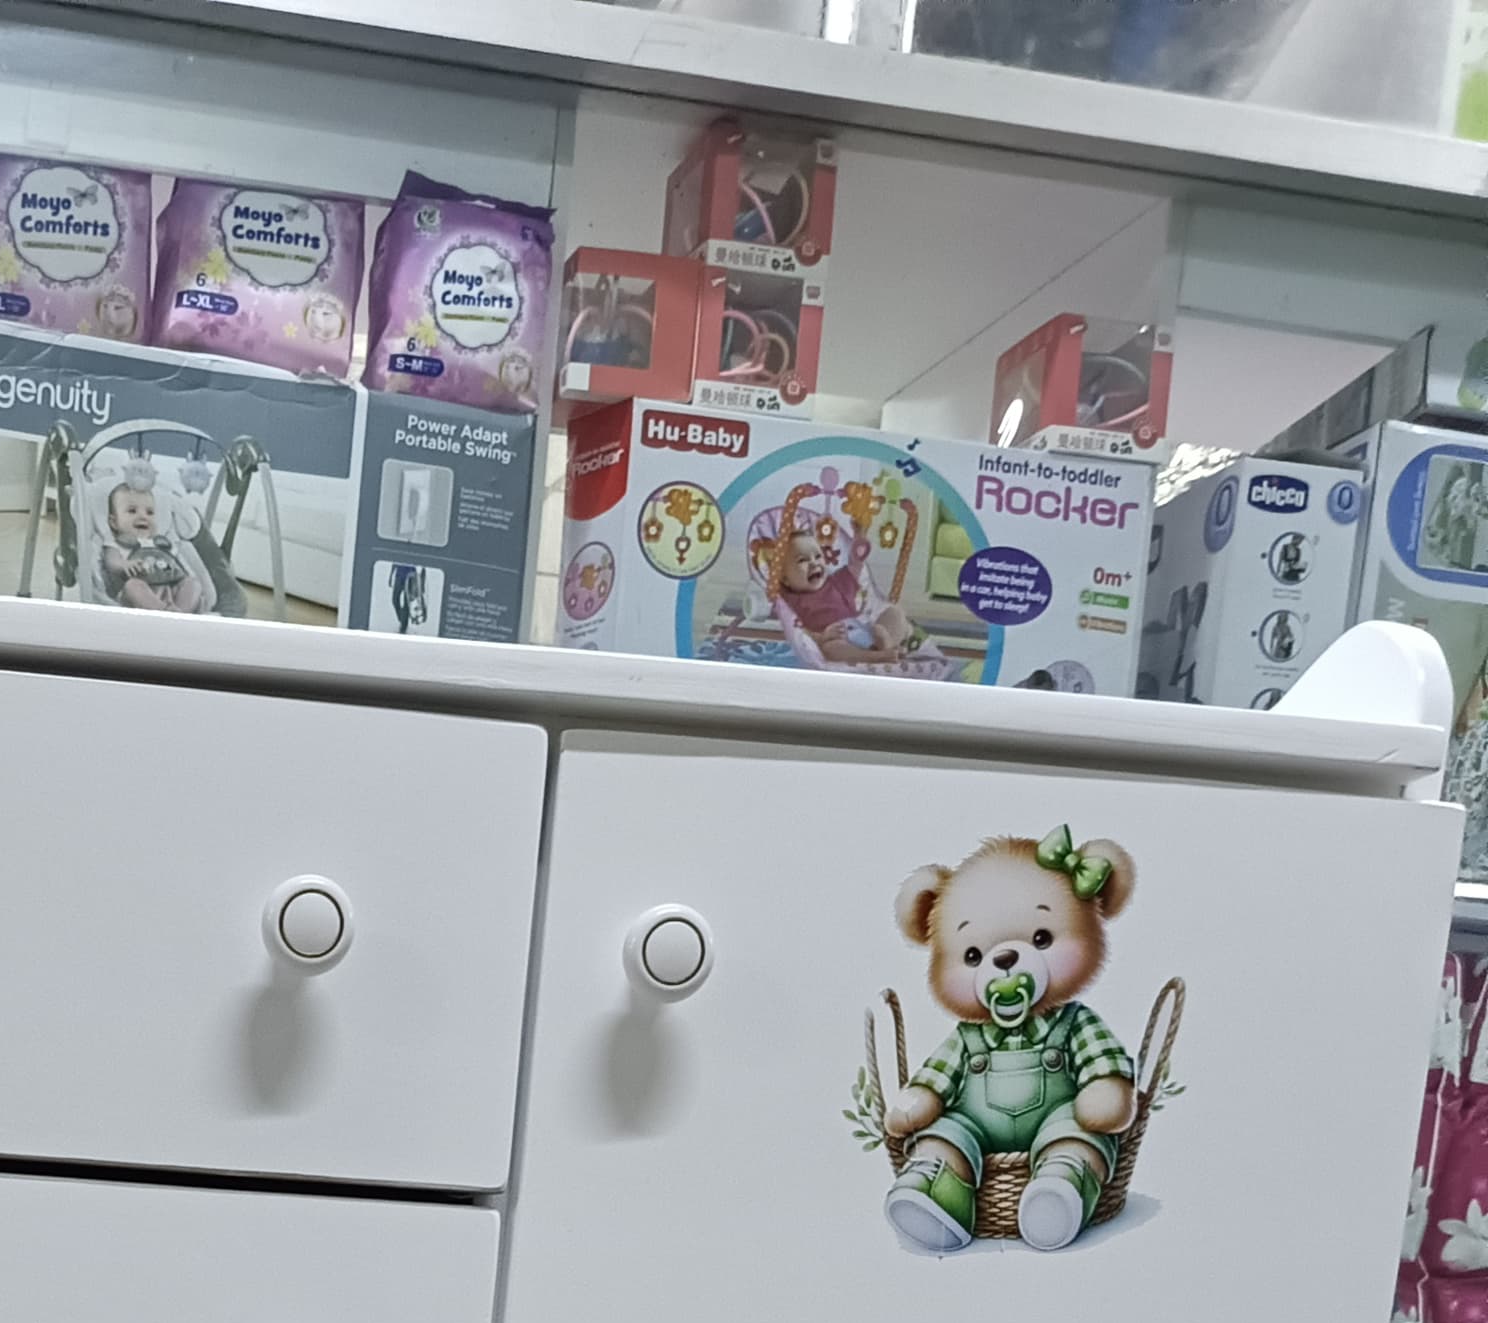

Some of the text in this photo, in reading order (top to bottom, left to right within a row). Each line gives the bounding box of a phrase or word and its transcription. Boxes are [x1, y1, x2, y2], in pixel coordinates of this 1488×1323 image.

[20, 193, 72, 217] Moyo
[232, 205, 284, 228] Moyo
[19, 215, 110, 237] Comforts
[231, 224, 321, 250] Comforts
[195, 272, 208, 288] 6
[443, 269, 483, 291] Moyo
[441, 290, 513, 309] Comforts
[406, 337, 417, 352] 6
[394, 428, 461, 454] Portable
[407, 414, 509, 447] Power Adapt
[647, 418, 745, 453] Hu-Baby
[978, 454, 1122, 489] Infant-to-toddler
[974, 474, 1140, 530] Rocker
[1250, 479, 1306, 508] chicco
